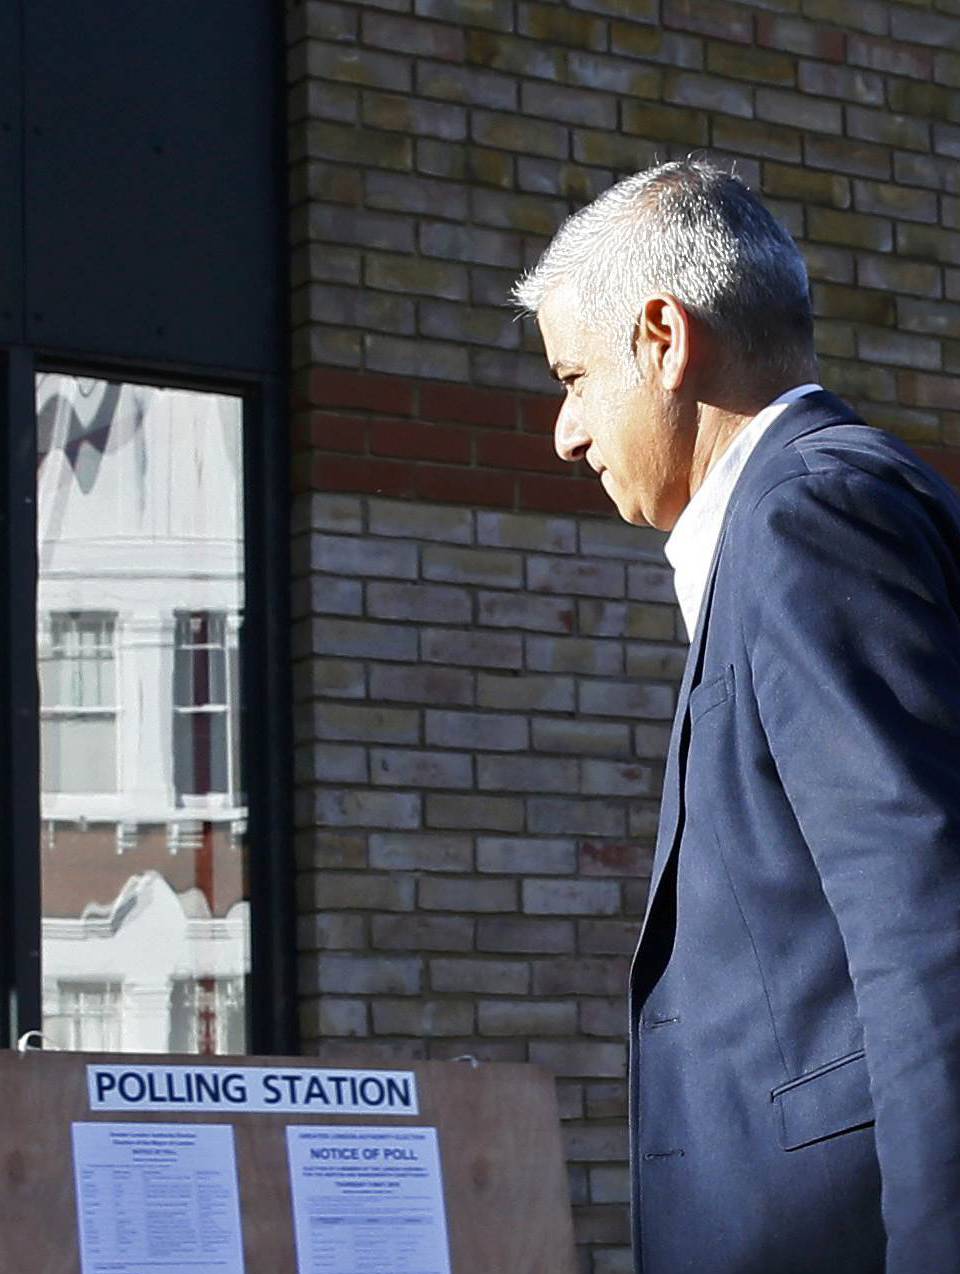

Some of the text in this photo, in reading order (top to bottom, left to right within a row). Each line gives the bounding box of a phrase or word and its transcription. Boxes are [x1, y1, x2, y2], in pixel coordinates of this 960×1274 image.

[95, 1072, 412, 1107] POLLING STATION
[310, 1148, 418, 1161] NOTICE OF POLL
